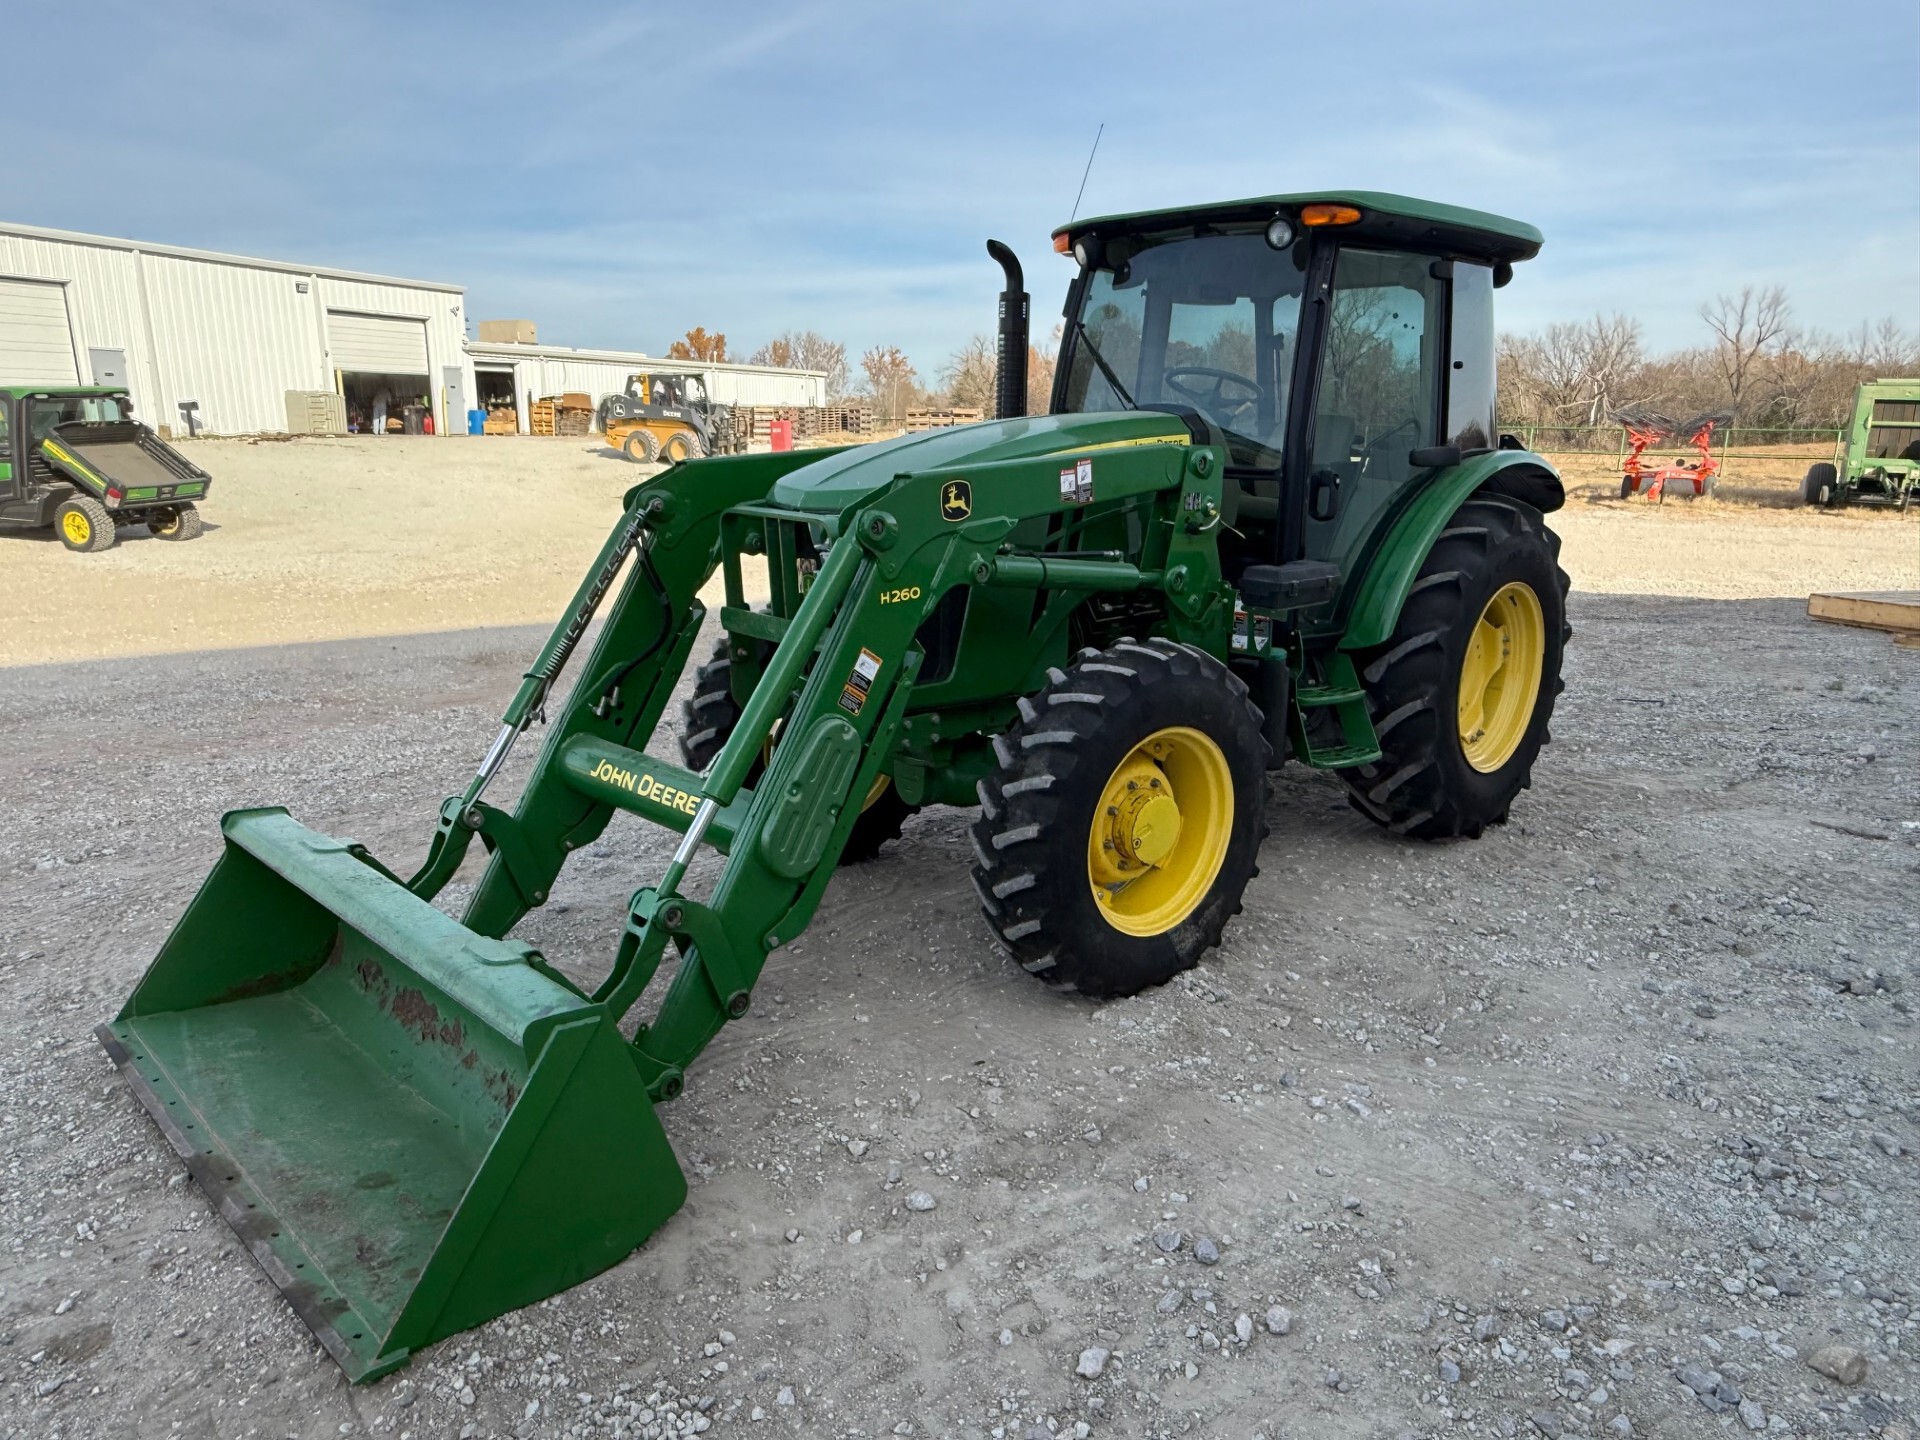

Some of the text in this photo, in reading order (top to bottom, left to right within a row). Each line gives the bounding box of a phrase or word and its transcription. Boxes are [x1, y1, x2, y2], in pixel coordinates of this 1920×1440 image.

[880, 586, 921, 605] H260
[590, 758, 702, 816] JOHN DEERE
